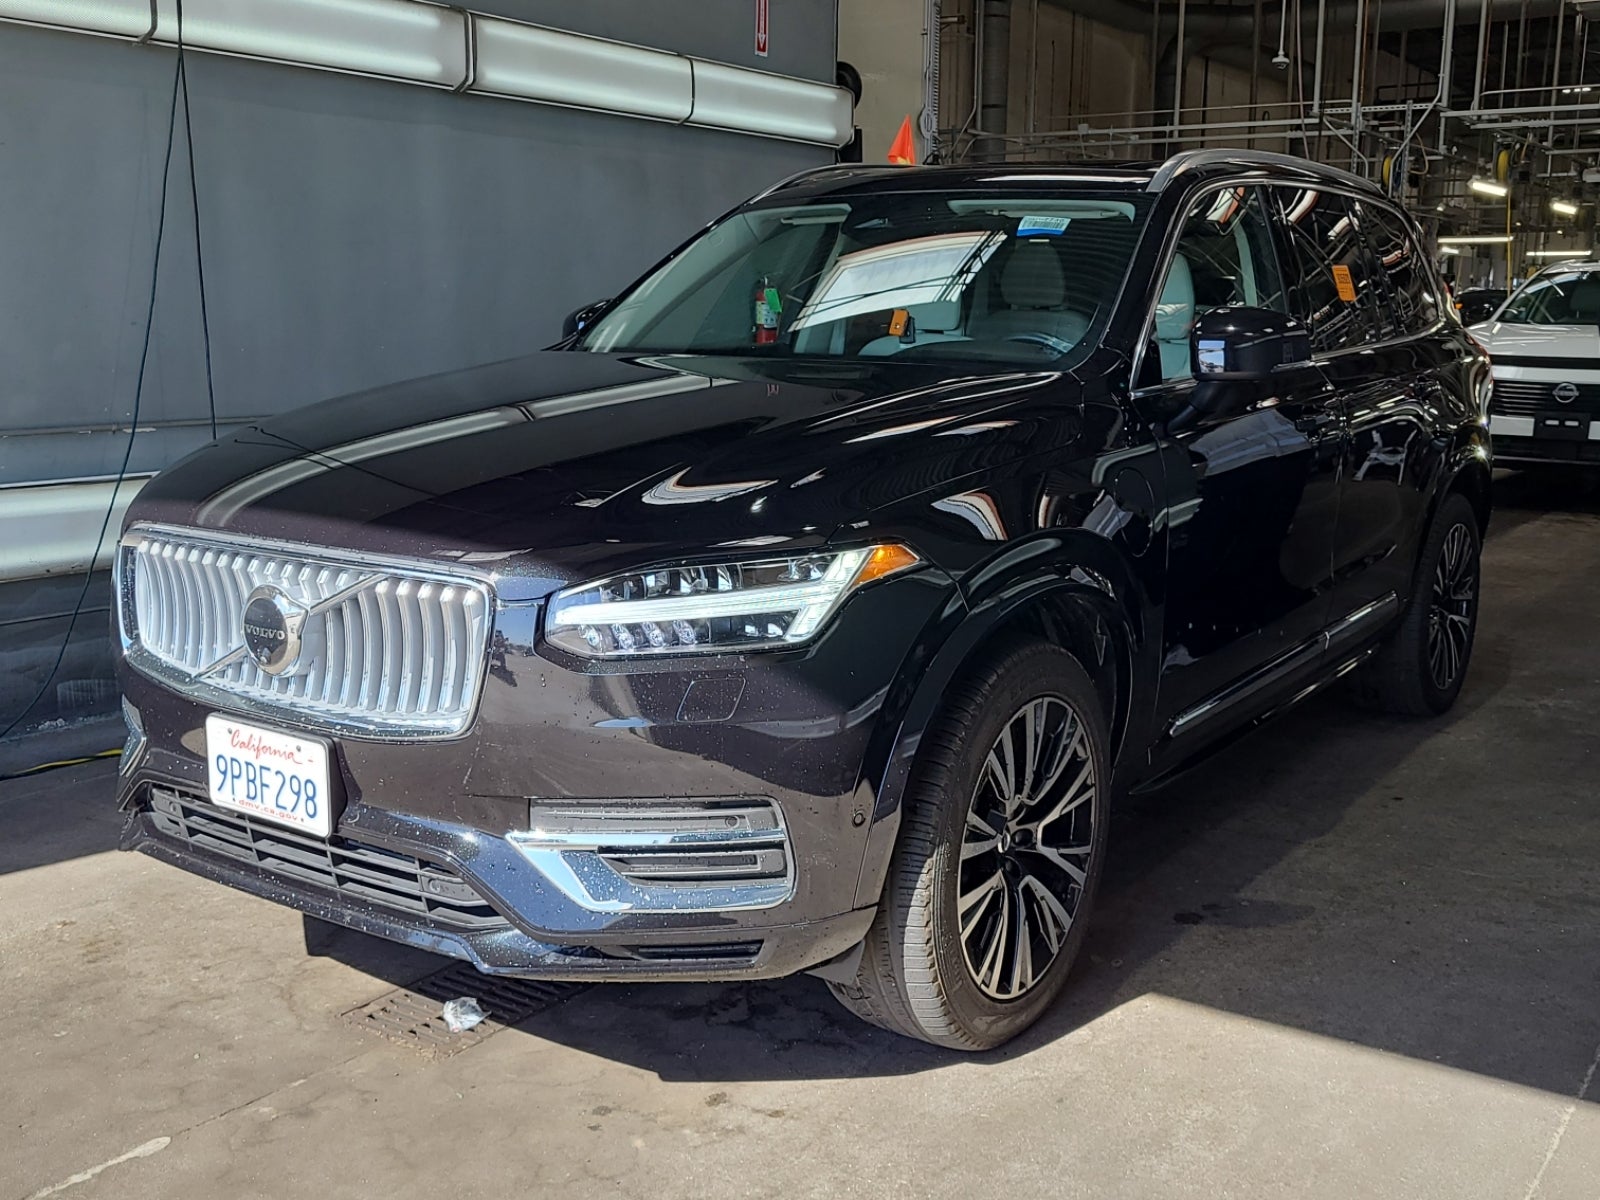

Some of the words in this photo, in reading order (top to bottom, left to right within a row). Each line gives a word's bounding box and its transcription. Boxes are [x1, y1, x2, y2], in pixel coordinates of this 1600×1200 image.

[244, 623, 286, 640] VOLVO
[230, 729, 303, 765] California
[216, 754, 318, 819] 9PBF298
[238, 799, 298, 821] dmv.ca.gov
